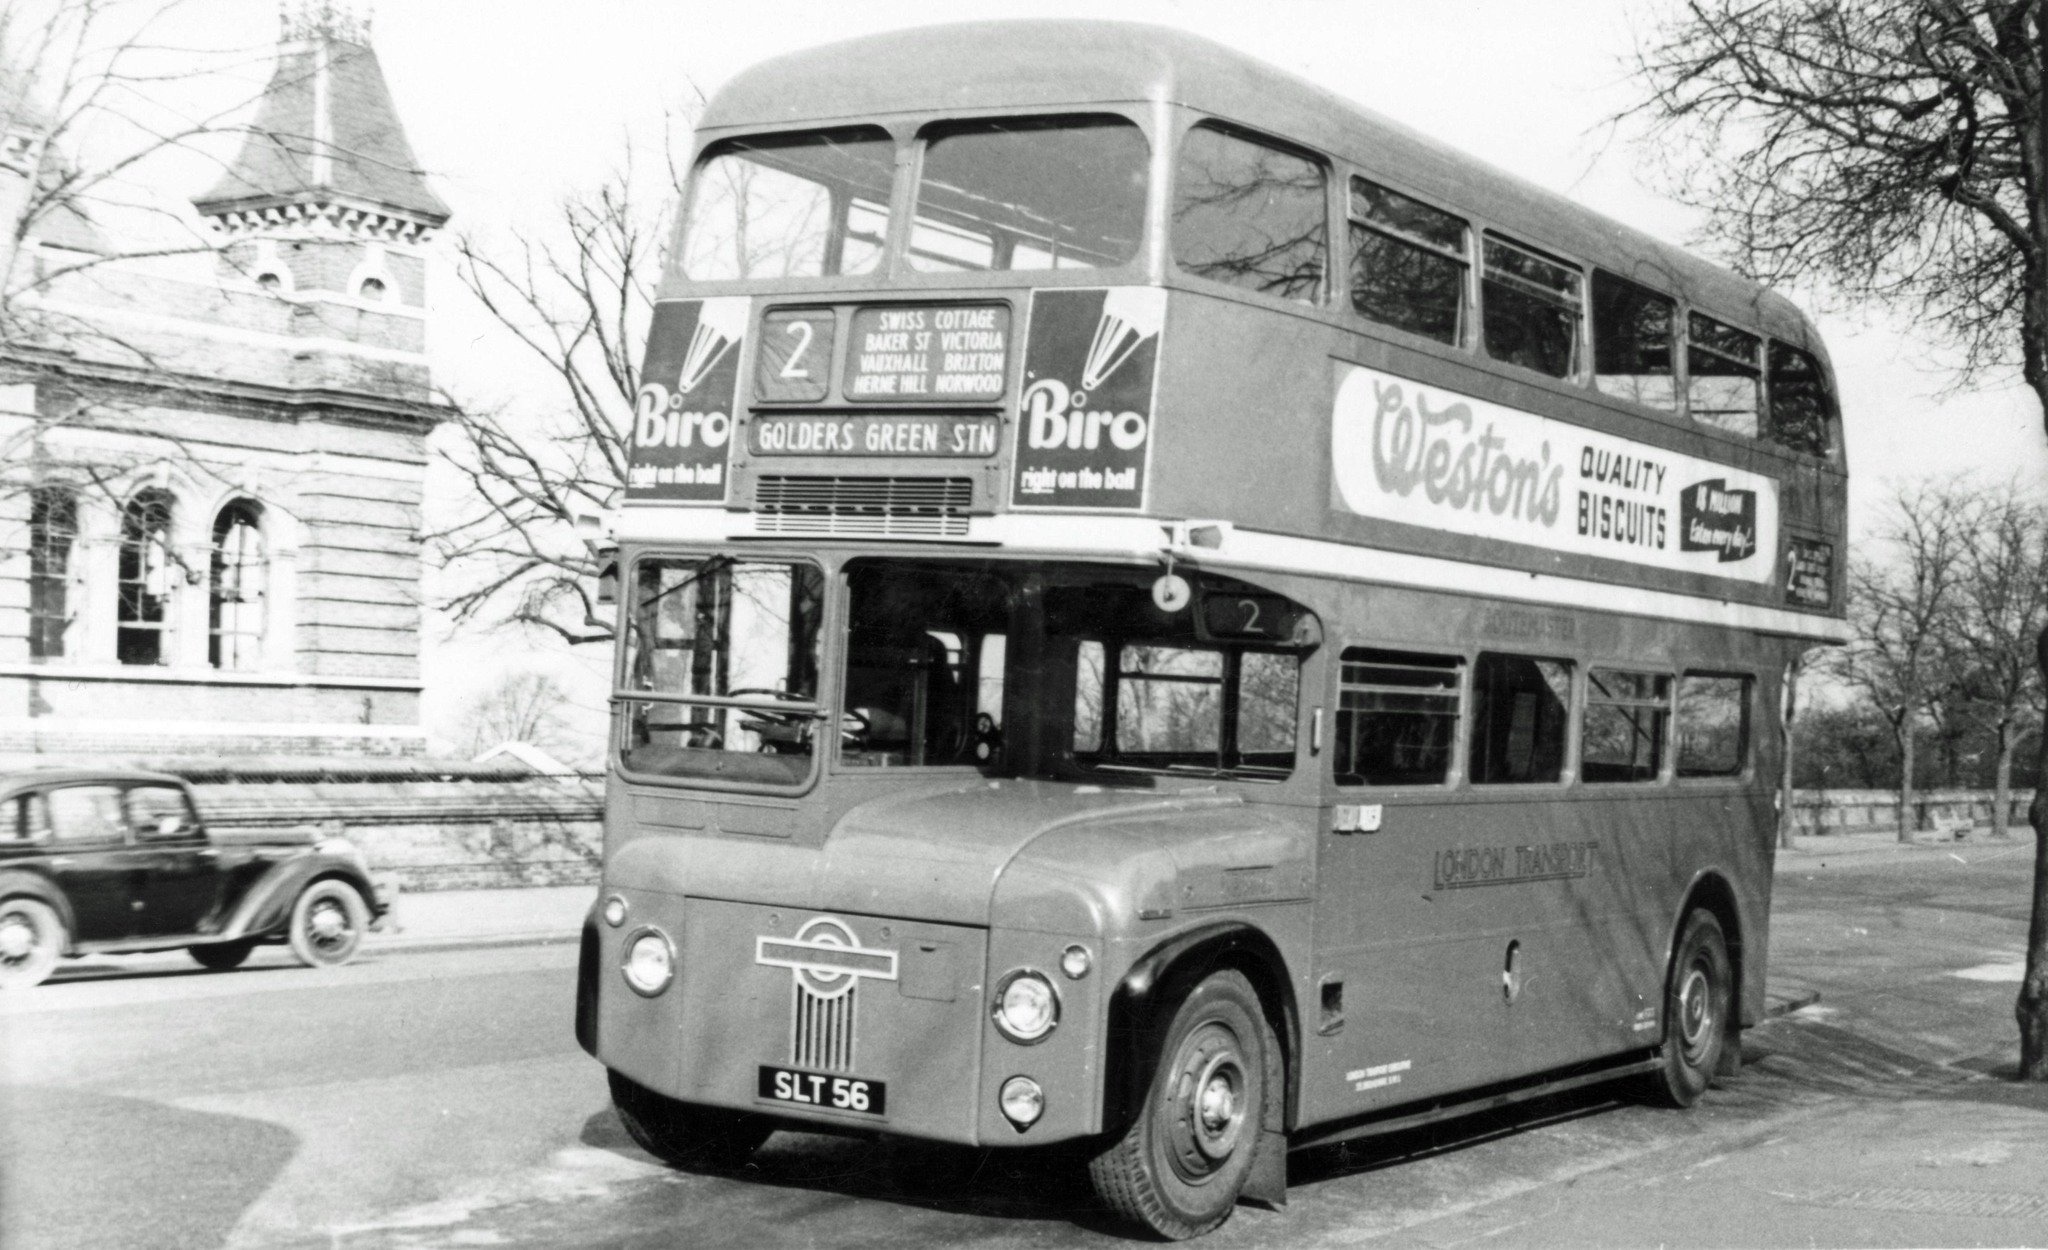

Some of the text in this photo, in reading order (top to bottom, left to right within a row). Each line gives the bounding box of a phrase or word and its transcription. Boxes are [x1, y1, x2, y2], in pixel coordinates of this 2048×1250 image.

[879, 310, 997, 331] SWISS COTTAGE
[780, 321, 814, 378] 2
[865, 331, 1004, 352] BAKER ST VICTORIA
[860, 352, 1005, 373] VAUXHALL BRIXTON
[853, 373, 1004, 394] HERNE HILL NORWOOD
[634, 382, 730, 448] Biro
[1021, 378, 1147, 450] Biro
[759, 422, 996, 453] GOLDERS GREEN STN
[1373, 379, 1564, 528] Weston's
[628, 462, 722, 488] right on the ball
[1021, 465, 1137, 494] right on the ball
[1581, 445, 1667, 495] QUALITY
[1578, 490, 1666, 550] BISCUITS
[1238, 600, 1264, 632] 2
[1434, 841, 1599, 890] LONDON TRANSPORT
[774, 1071, 870, 1111] SLT 56
